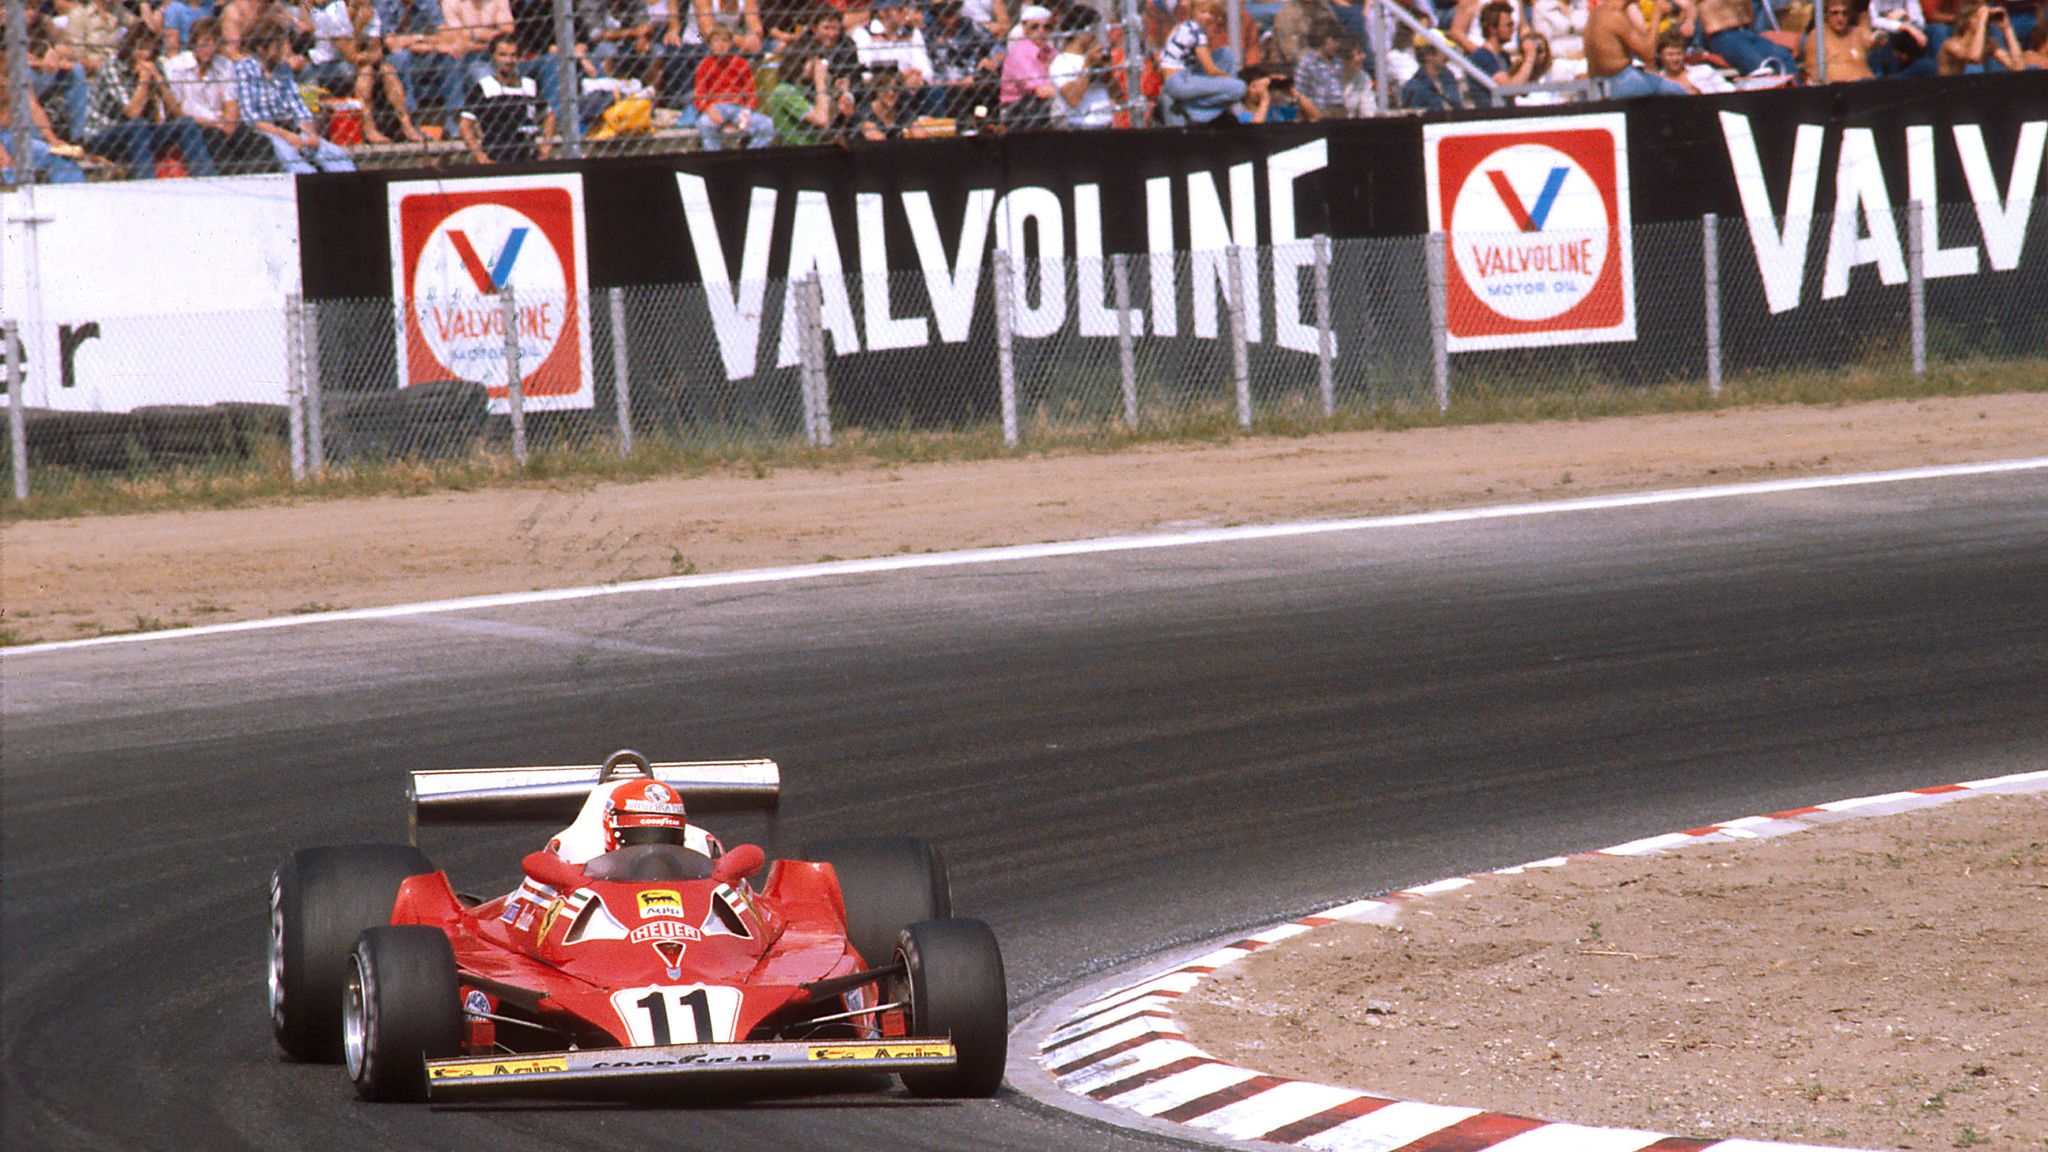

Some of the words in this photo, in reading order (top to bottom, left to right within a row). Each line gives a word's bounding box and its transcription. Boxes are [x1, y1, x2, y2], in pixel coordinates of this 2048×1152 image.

[1718, 111, 2048, 315] VALV
[676, 138, 1338, 381] VALVOLINE
[1472, 239, 1592, 278] VALVOLINE
[1488, 282, 1546, 296] MOTOR
[1554, 281, 1578, 293] OIL
[434, 302, 552, 342] VALVOINE
[635, 922, 697, 938] HEUER
[636, 988, 714, 1045] 11
